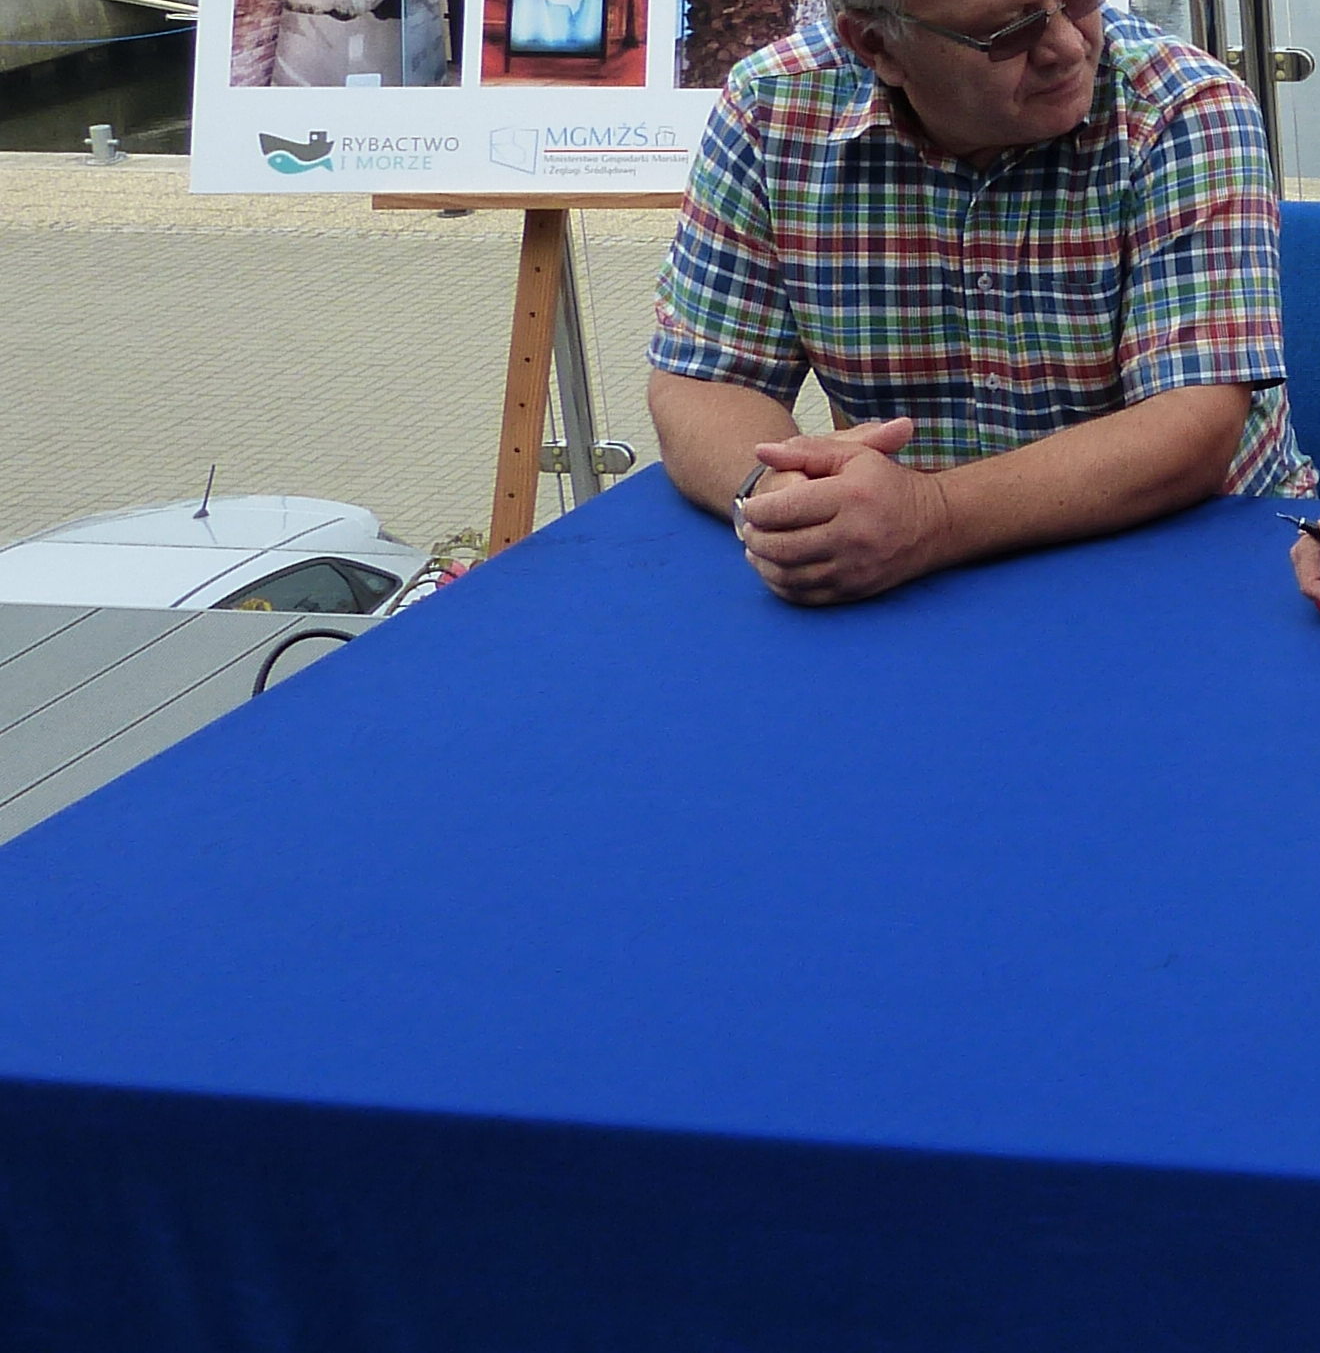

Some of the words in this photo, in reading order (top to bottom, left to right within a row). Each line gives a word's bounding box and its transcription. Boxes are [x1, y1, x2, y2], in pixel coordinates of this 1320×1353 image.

[342, 136, 460, 152] RYBACTWO
[340, 155, 346, 170] I
[356, 155, 433, 171] MORZE
